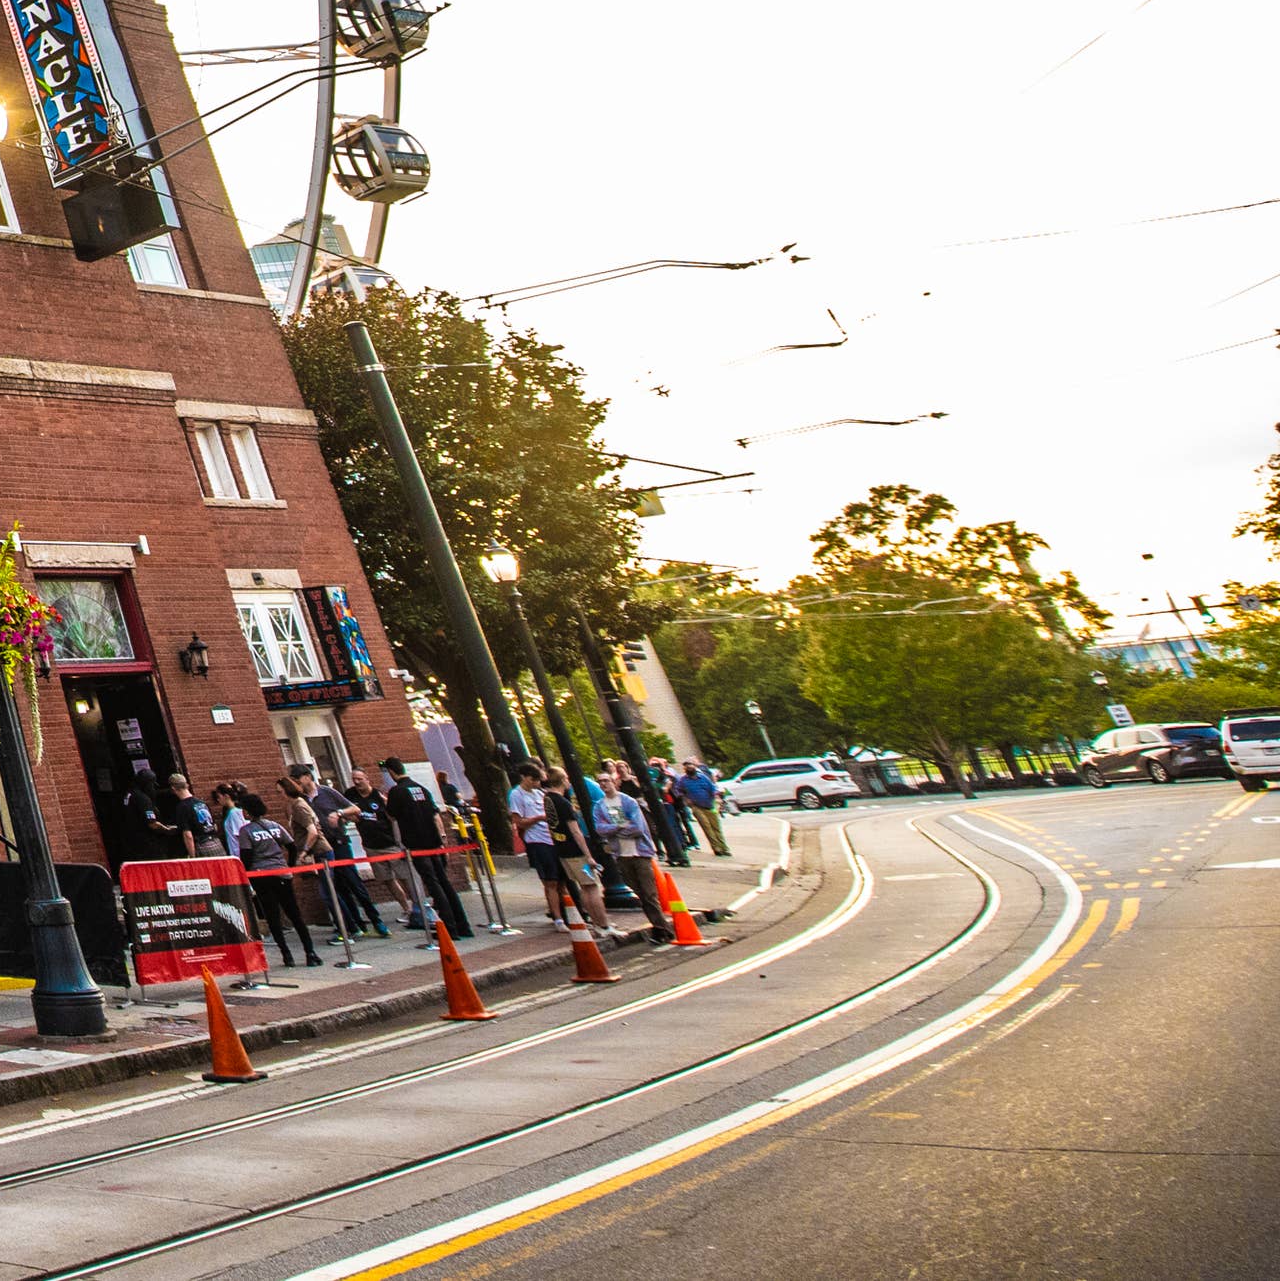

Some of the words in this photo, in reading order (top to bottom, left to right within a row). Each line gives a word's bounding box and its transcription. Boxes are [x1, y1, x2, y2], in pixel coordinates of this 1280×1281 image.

[288, 685, 352, 702] OFFICE
[253, 828, 281, 842] STAFF
[135, 905, 151, 917] LIVE
[151, 904, 175, 916] NATION
